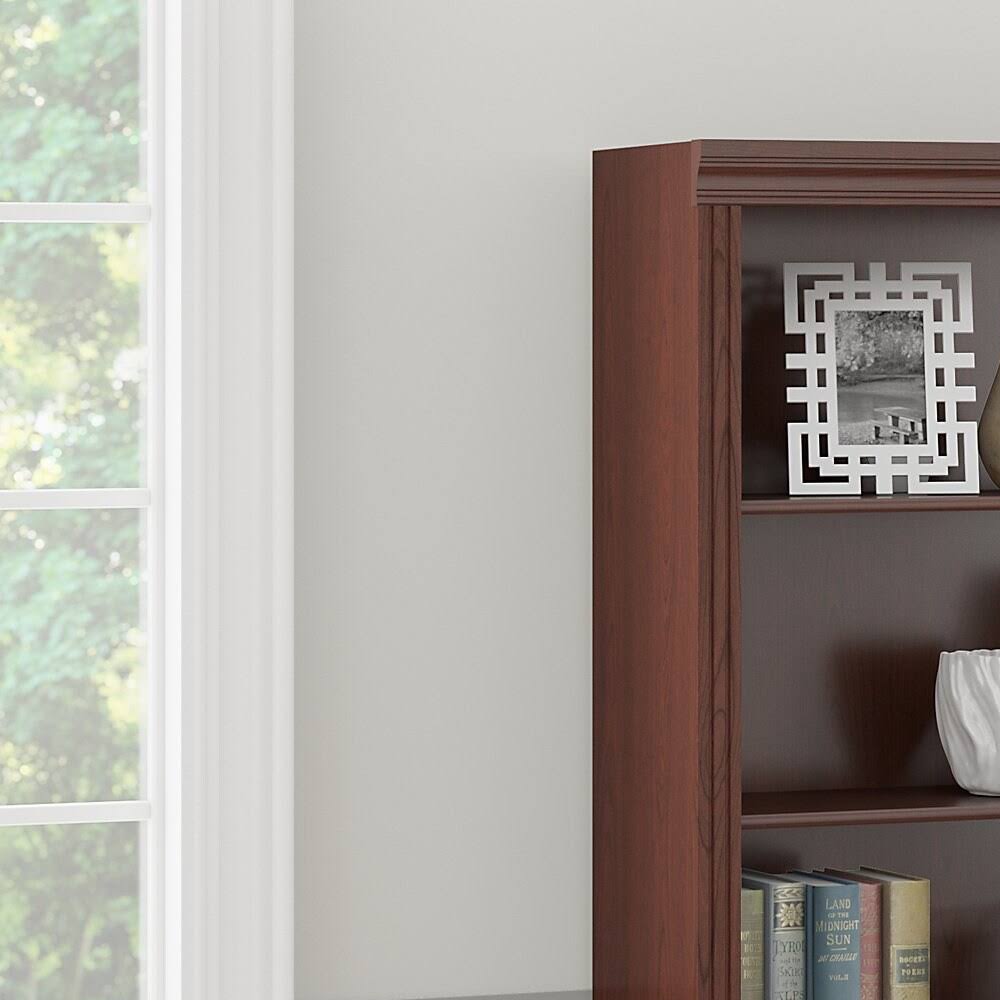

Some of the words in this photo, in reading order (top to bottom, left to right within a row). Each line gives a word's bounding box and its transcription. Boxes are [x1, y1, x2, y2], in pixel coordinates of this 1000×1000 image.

[826, 898, 851, 910] LAND
[816, 919, 859, 933] MIDNIGHT
[826, 933, 851, 946] SUN
